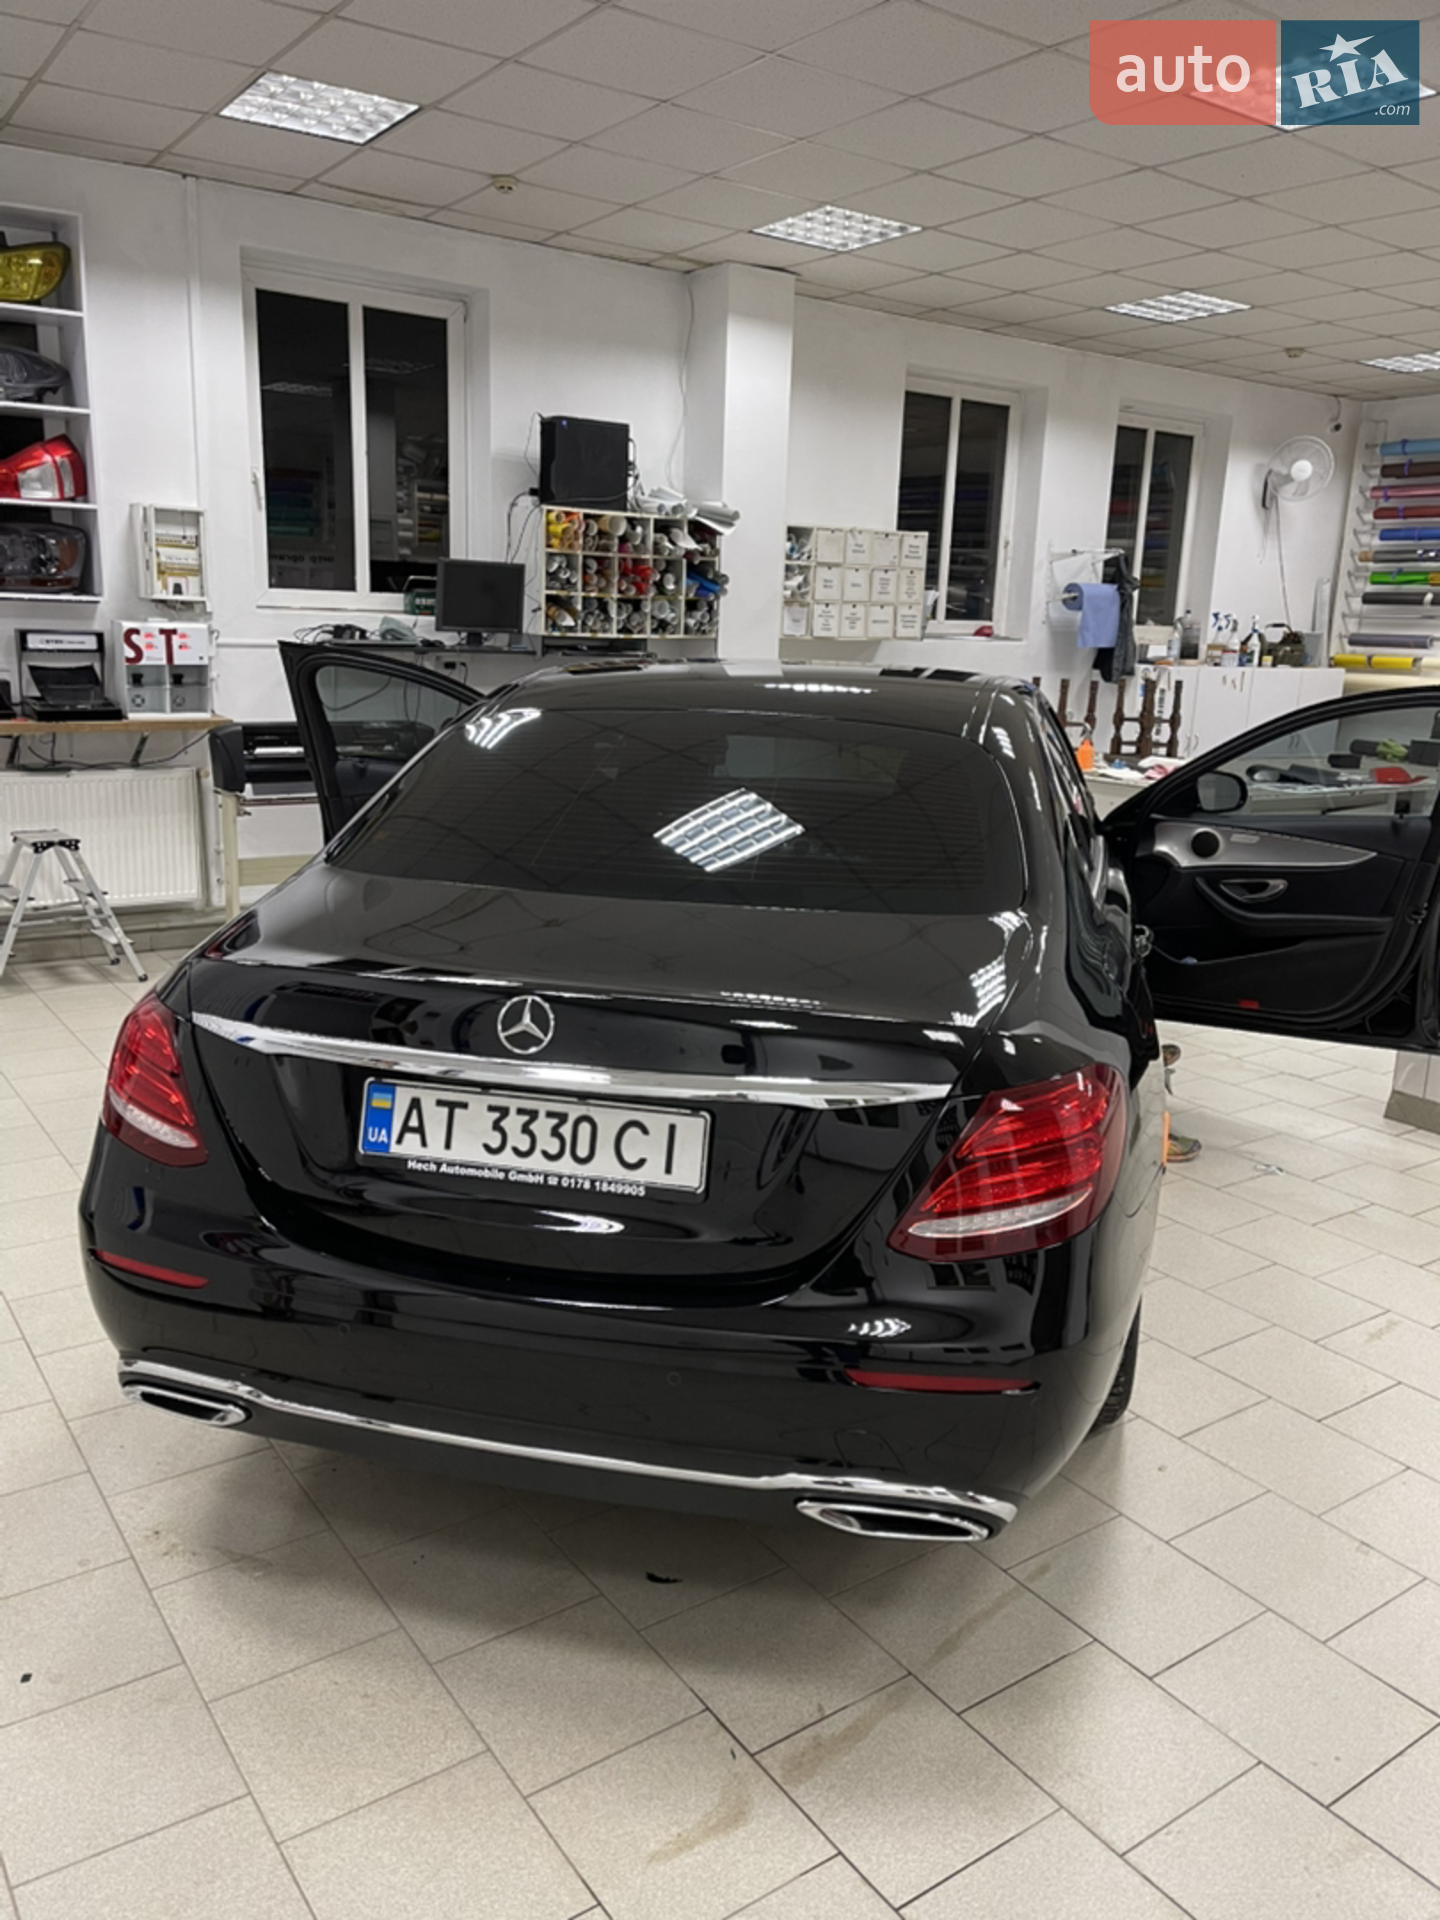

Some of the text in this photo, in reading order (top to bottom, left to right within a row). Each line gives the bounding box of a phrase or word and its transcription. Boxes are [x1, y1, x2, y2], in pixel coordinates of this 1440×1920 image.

[368, 1127, 388, 1144] UA
[395, 1097, 677, 1175] AT 3330 CI
[407, 1159, 437, 1173] Hech
[439, 1163, 505, 1180] Automobile
[508, 1170, 544, 1184] GmbH
[561, 1177, 591, 1190] 0178
